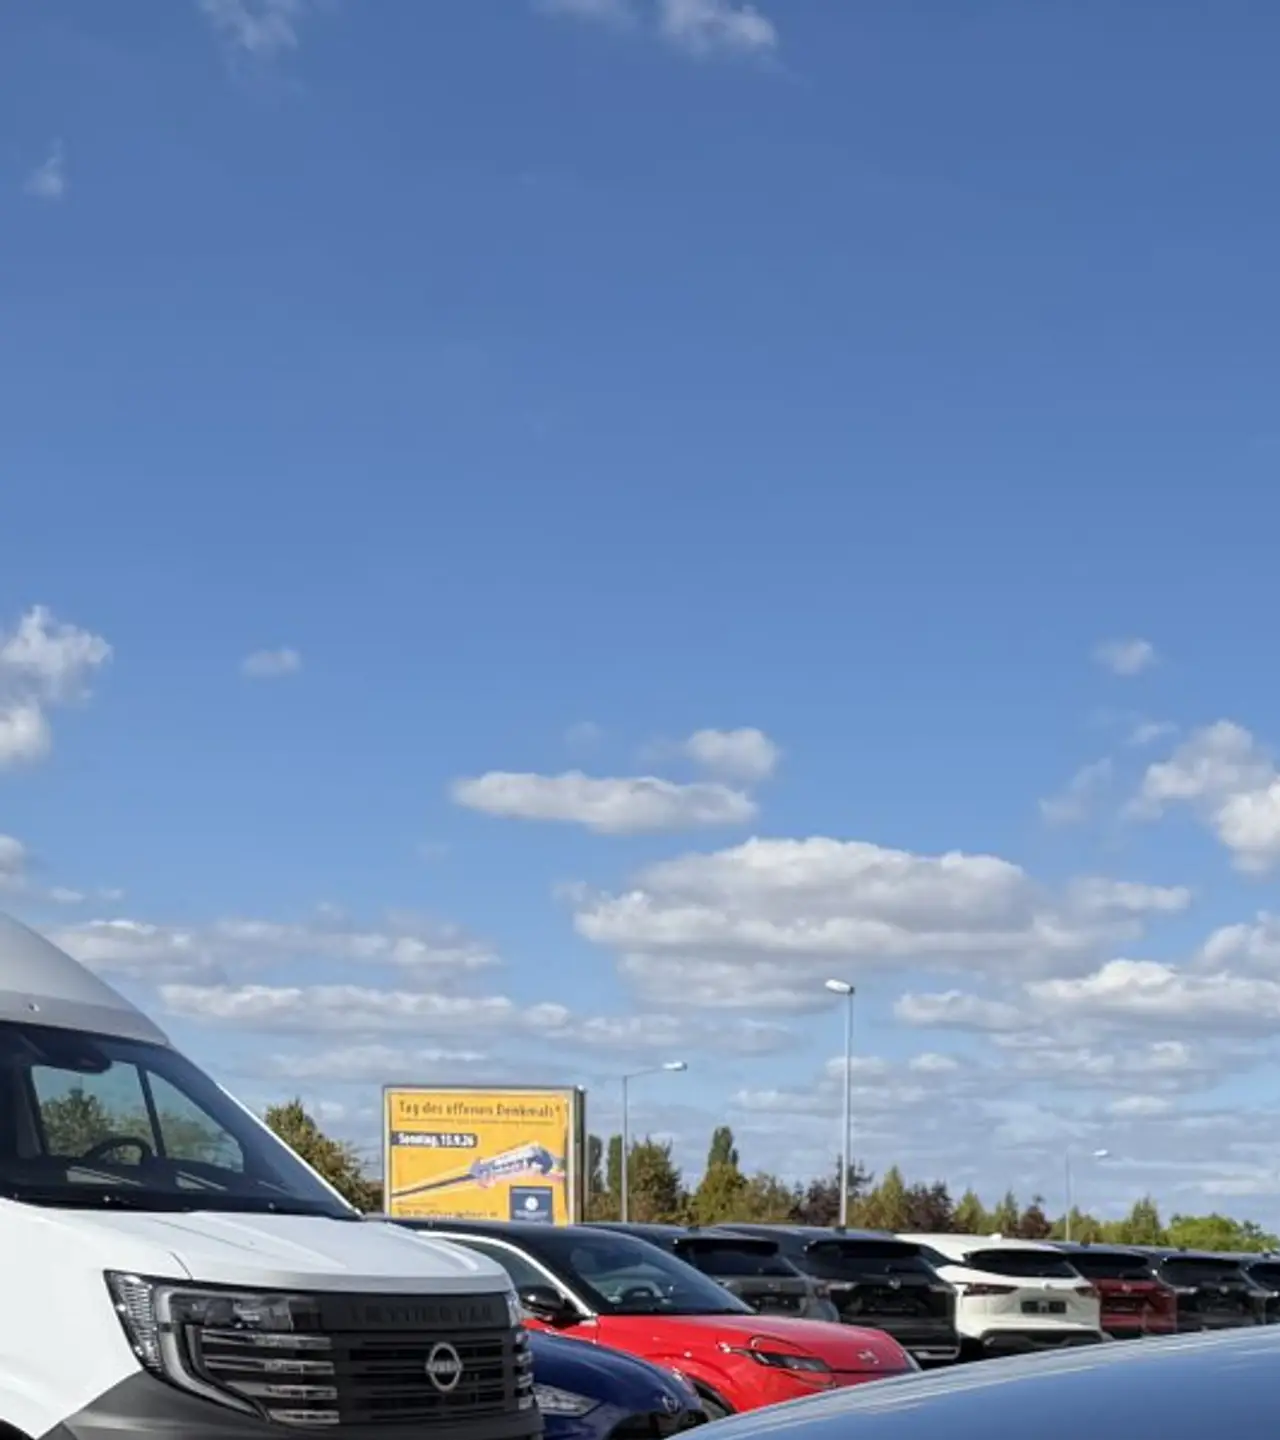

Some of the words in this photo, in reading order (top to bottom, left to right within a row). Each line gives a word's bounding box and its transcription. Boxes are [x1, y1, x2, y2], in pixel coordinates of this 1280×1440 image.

[399, 1100, 418, 1116] Tag
[422, 1101, 443, 1115] des
[446, 1102, 493, 1115] offenen
